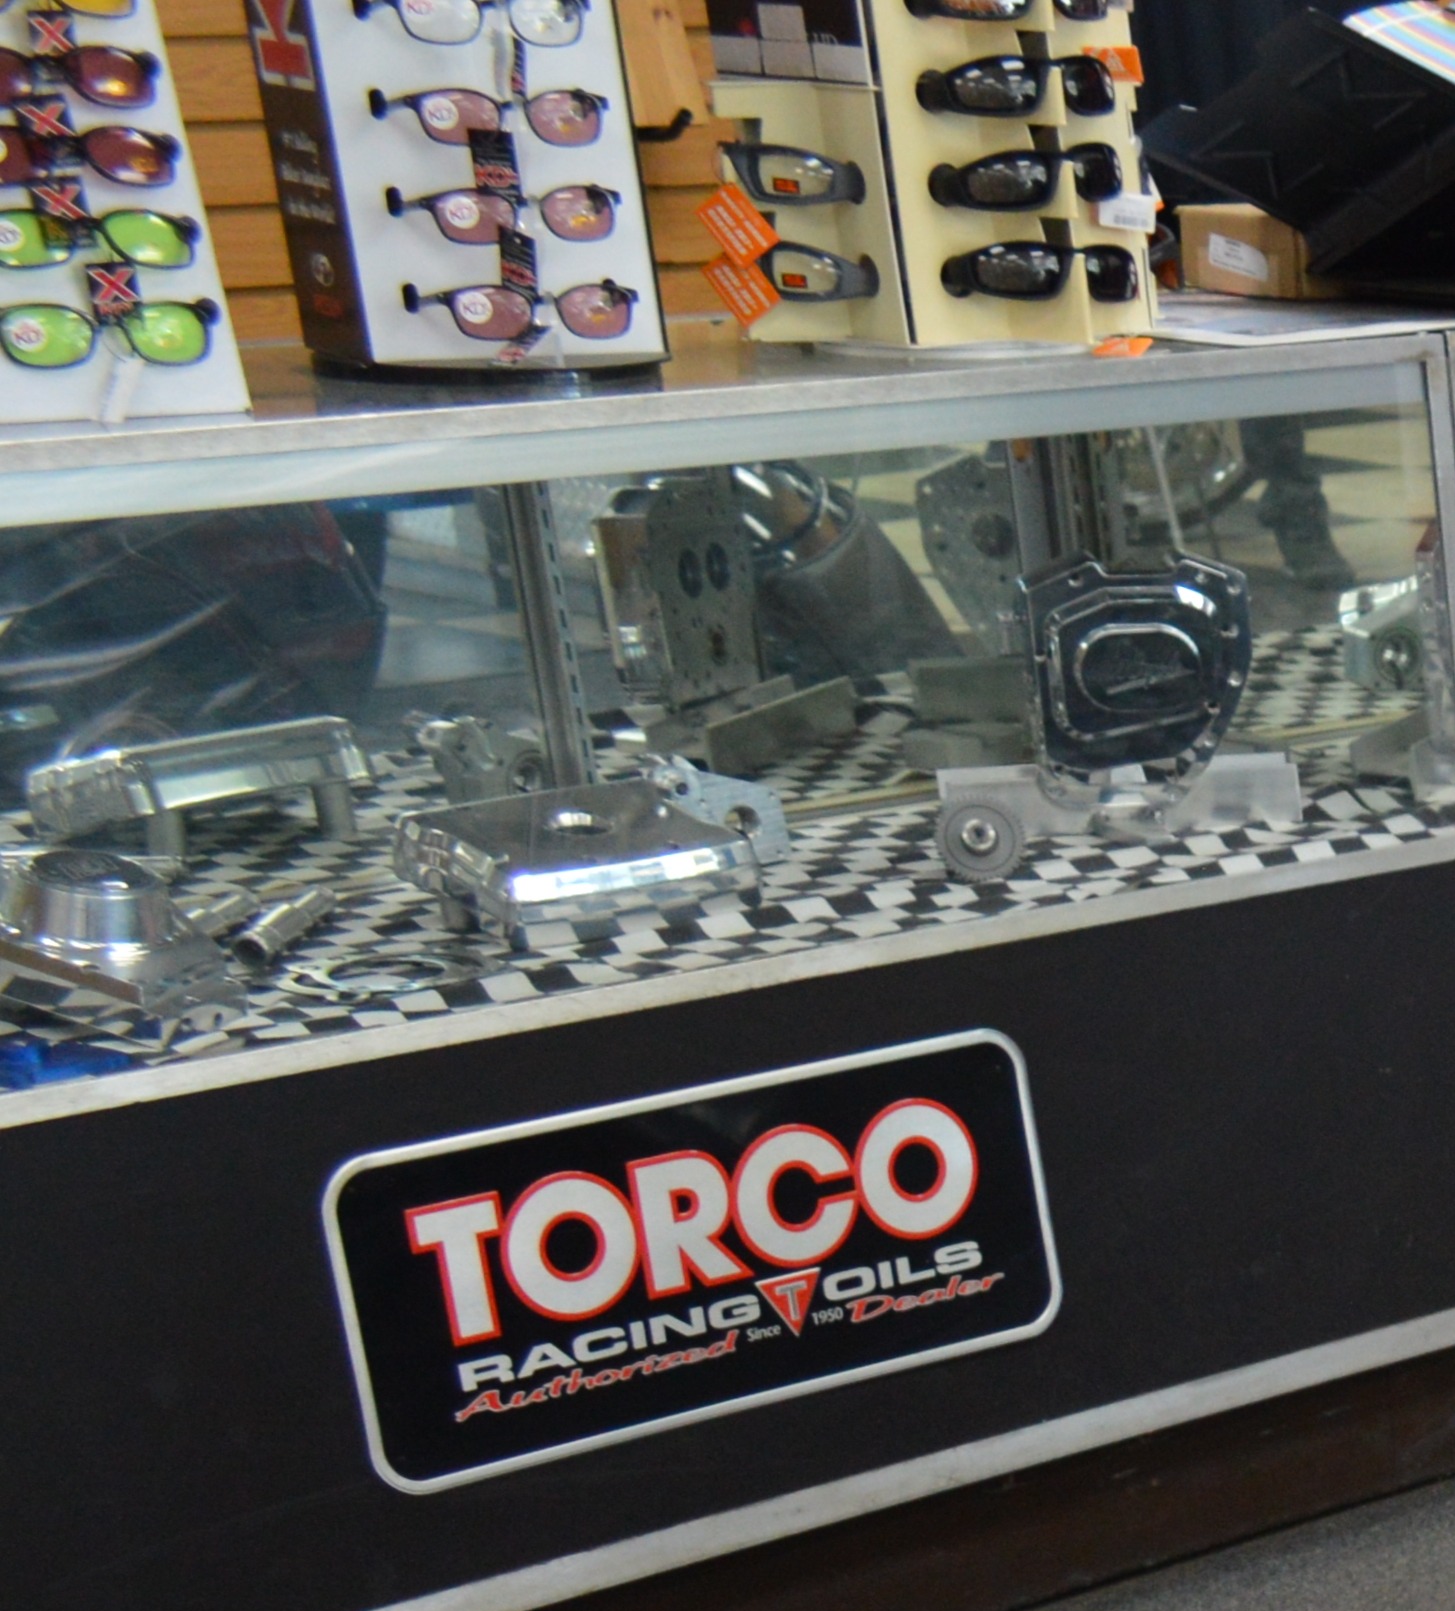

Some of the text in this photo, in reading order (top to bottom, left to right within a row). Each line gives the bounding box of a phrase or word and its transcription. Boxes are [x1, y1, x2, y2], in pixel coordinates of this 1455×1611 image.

[404, 1097, 979, 1347] TORCO
[454, 1272, 1006, 1424] Authorized Since 1950 Dealer
[458, 1293, 762, 1393] RACING
[822, 1240, 983, 1301] OILS
